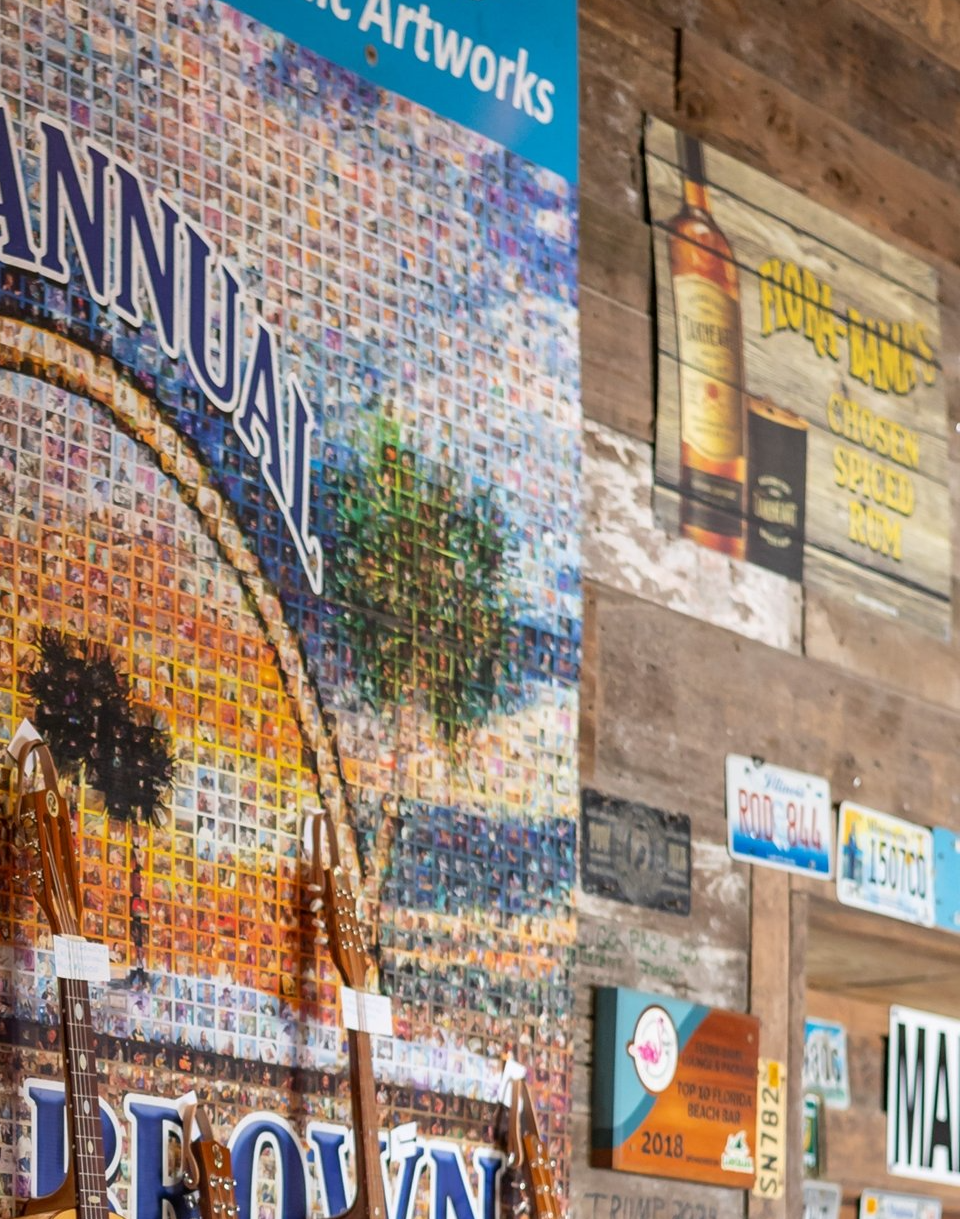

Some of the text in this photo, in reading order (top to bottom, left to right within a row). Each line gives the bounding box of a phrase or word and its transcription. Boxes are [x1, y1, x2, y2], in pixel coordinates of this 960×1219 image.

[357, 0, 556, 124] Artworks
[827, 392, 920, 469] CHOSEN
[833, 445, 914, 517] SPICED
[848, 503, 902, 562] RUM
[641, 1131, 684, 1158] 2018
[688, 1102, 741, 1125] BEACH BAR
